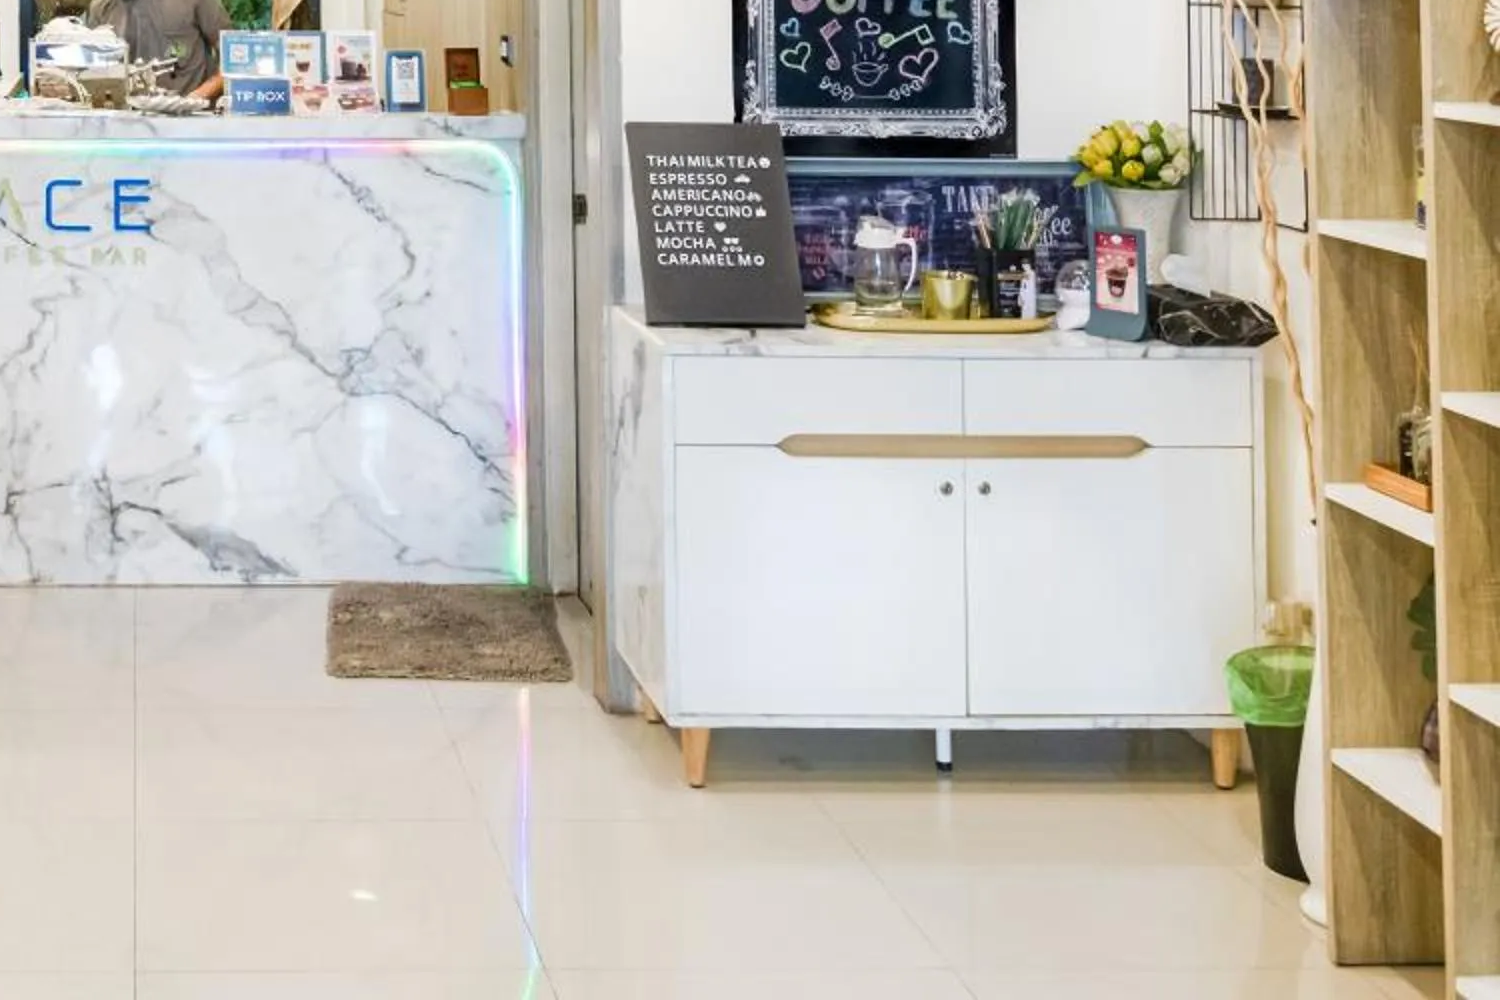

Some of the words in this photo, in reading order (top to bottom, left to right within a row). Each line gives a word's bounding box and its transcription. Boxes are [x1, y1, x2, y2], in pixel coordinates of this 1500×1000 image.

[646, 155, 685, 168] THAI
[649, 173, 728, 185] ESPRESSO
[651, 189, 746, 201] AMERICANO
[652, 205, 753, 217] CAPPUCCINO
[654, 221, 705, 233] LATTE
[656, 237, 717, 249] MOCHA
[91, 246, 148, 265] BAR
[657, 253, 735, 267] CARAMEL
